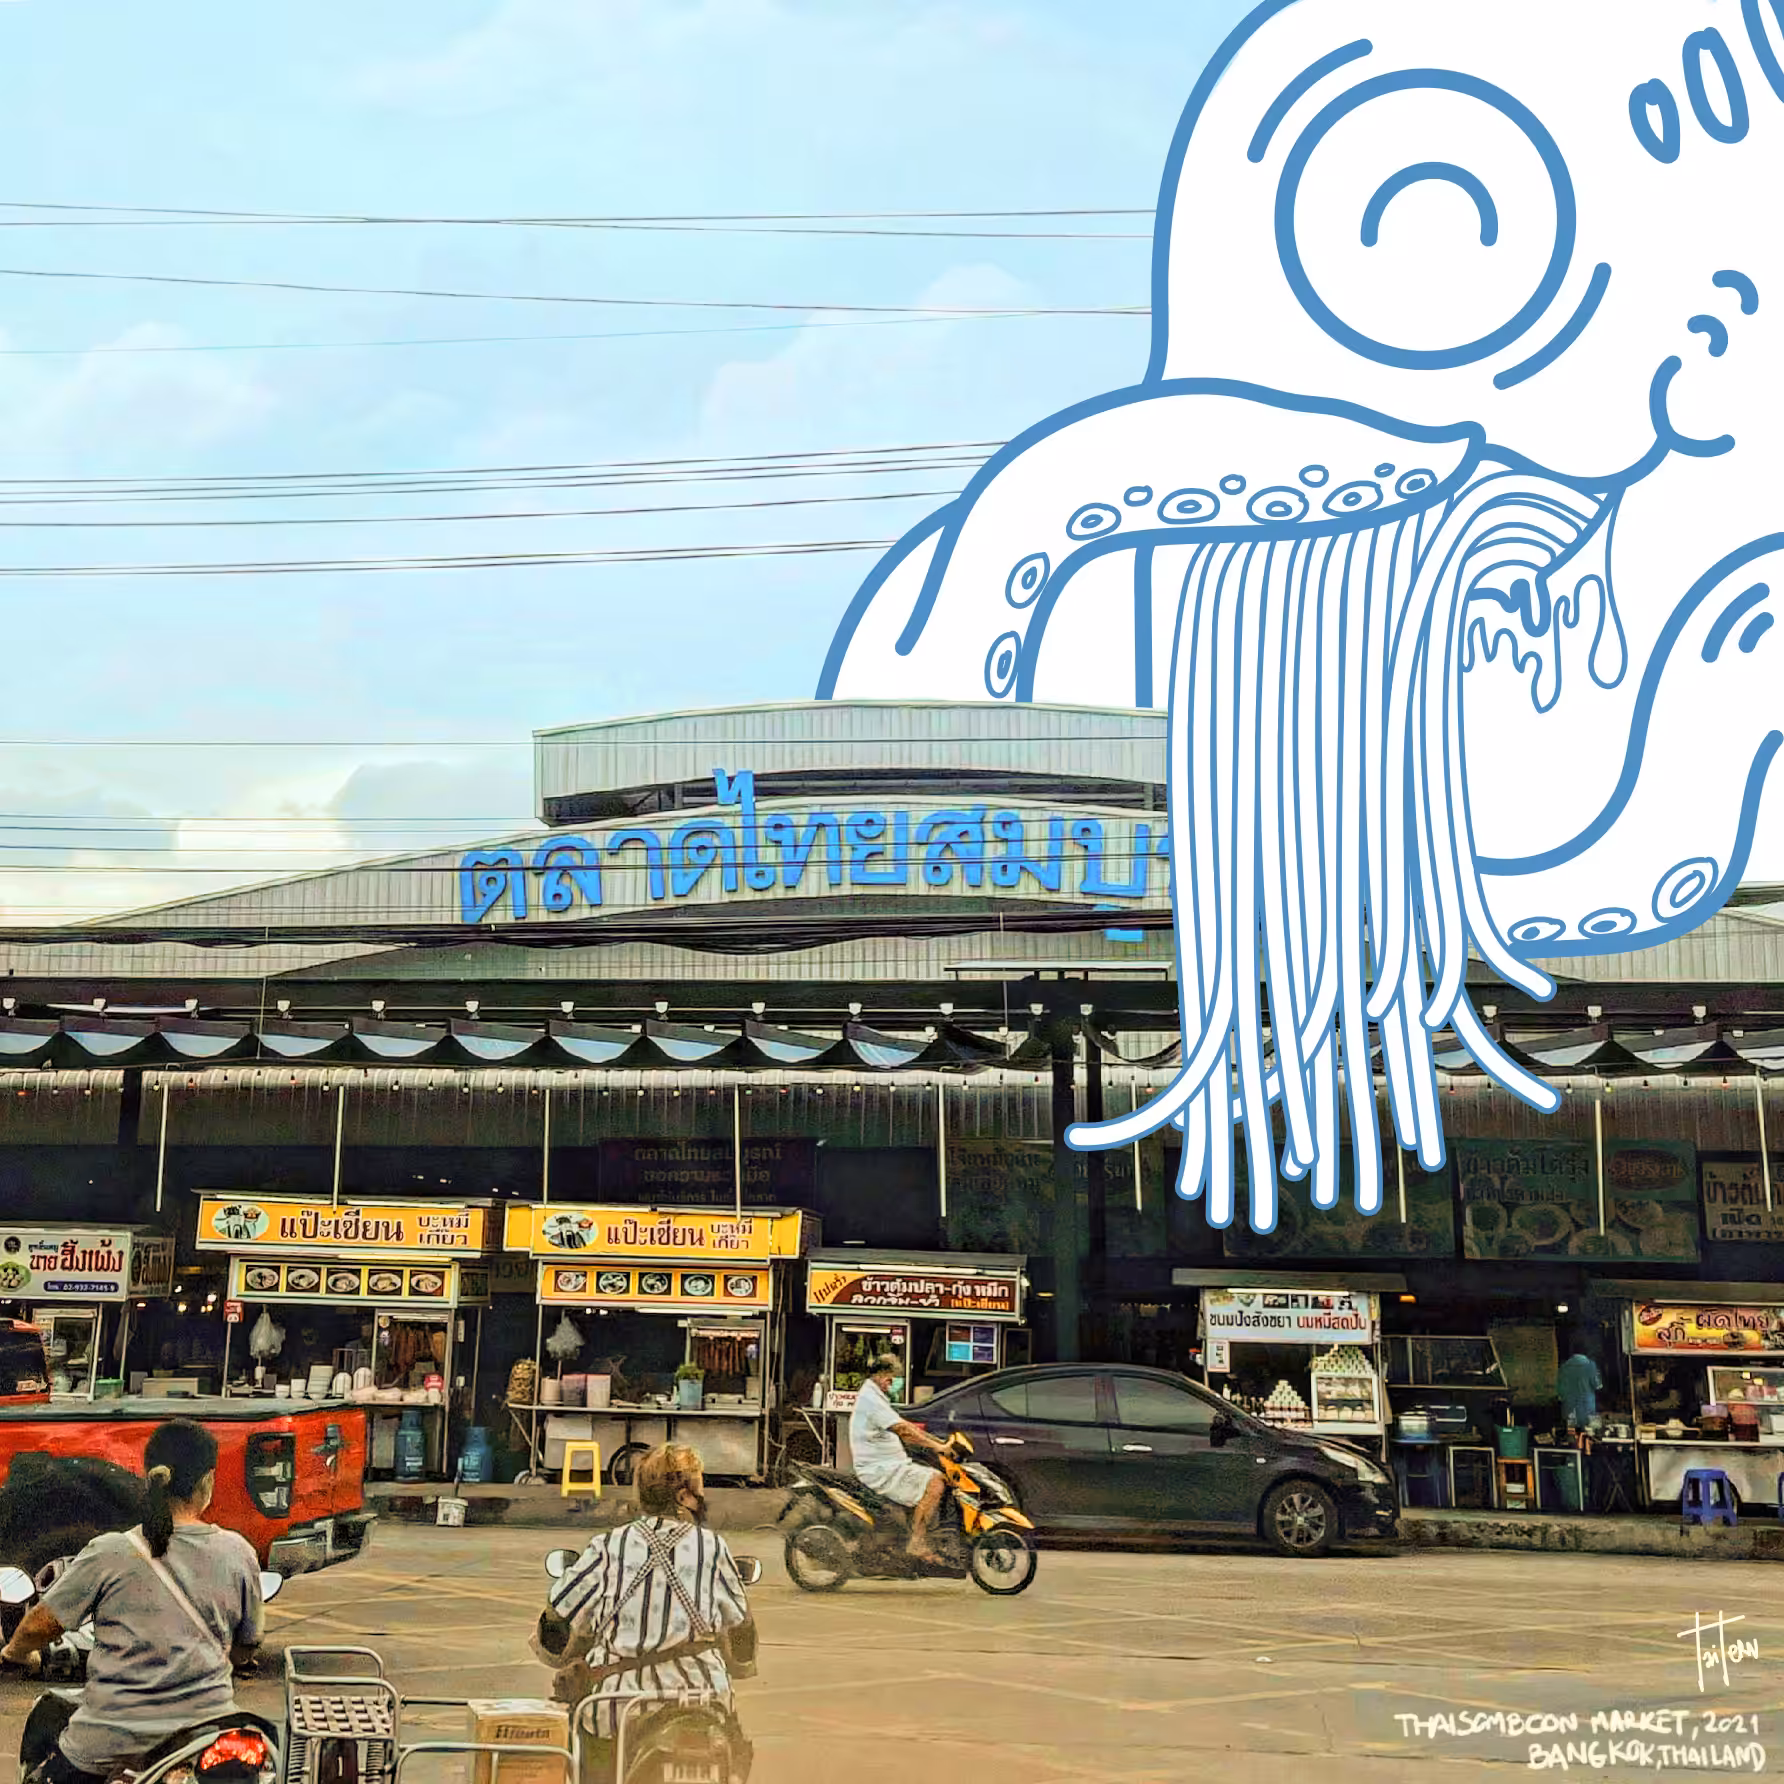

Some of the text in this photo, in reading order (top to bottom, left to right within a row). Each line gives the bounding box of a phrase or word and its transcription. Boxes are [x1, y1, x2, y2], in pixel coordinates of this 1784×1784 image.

[460, 768, 1171, 941] ตลาดไทยสมบู
